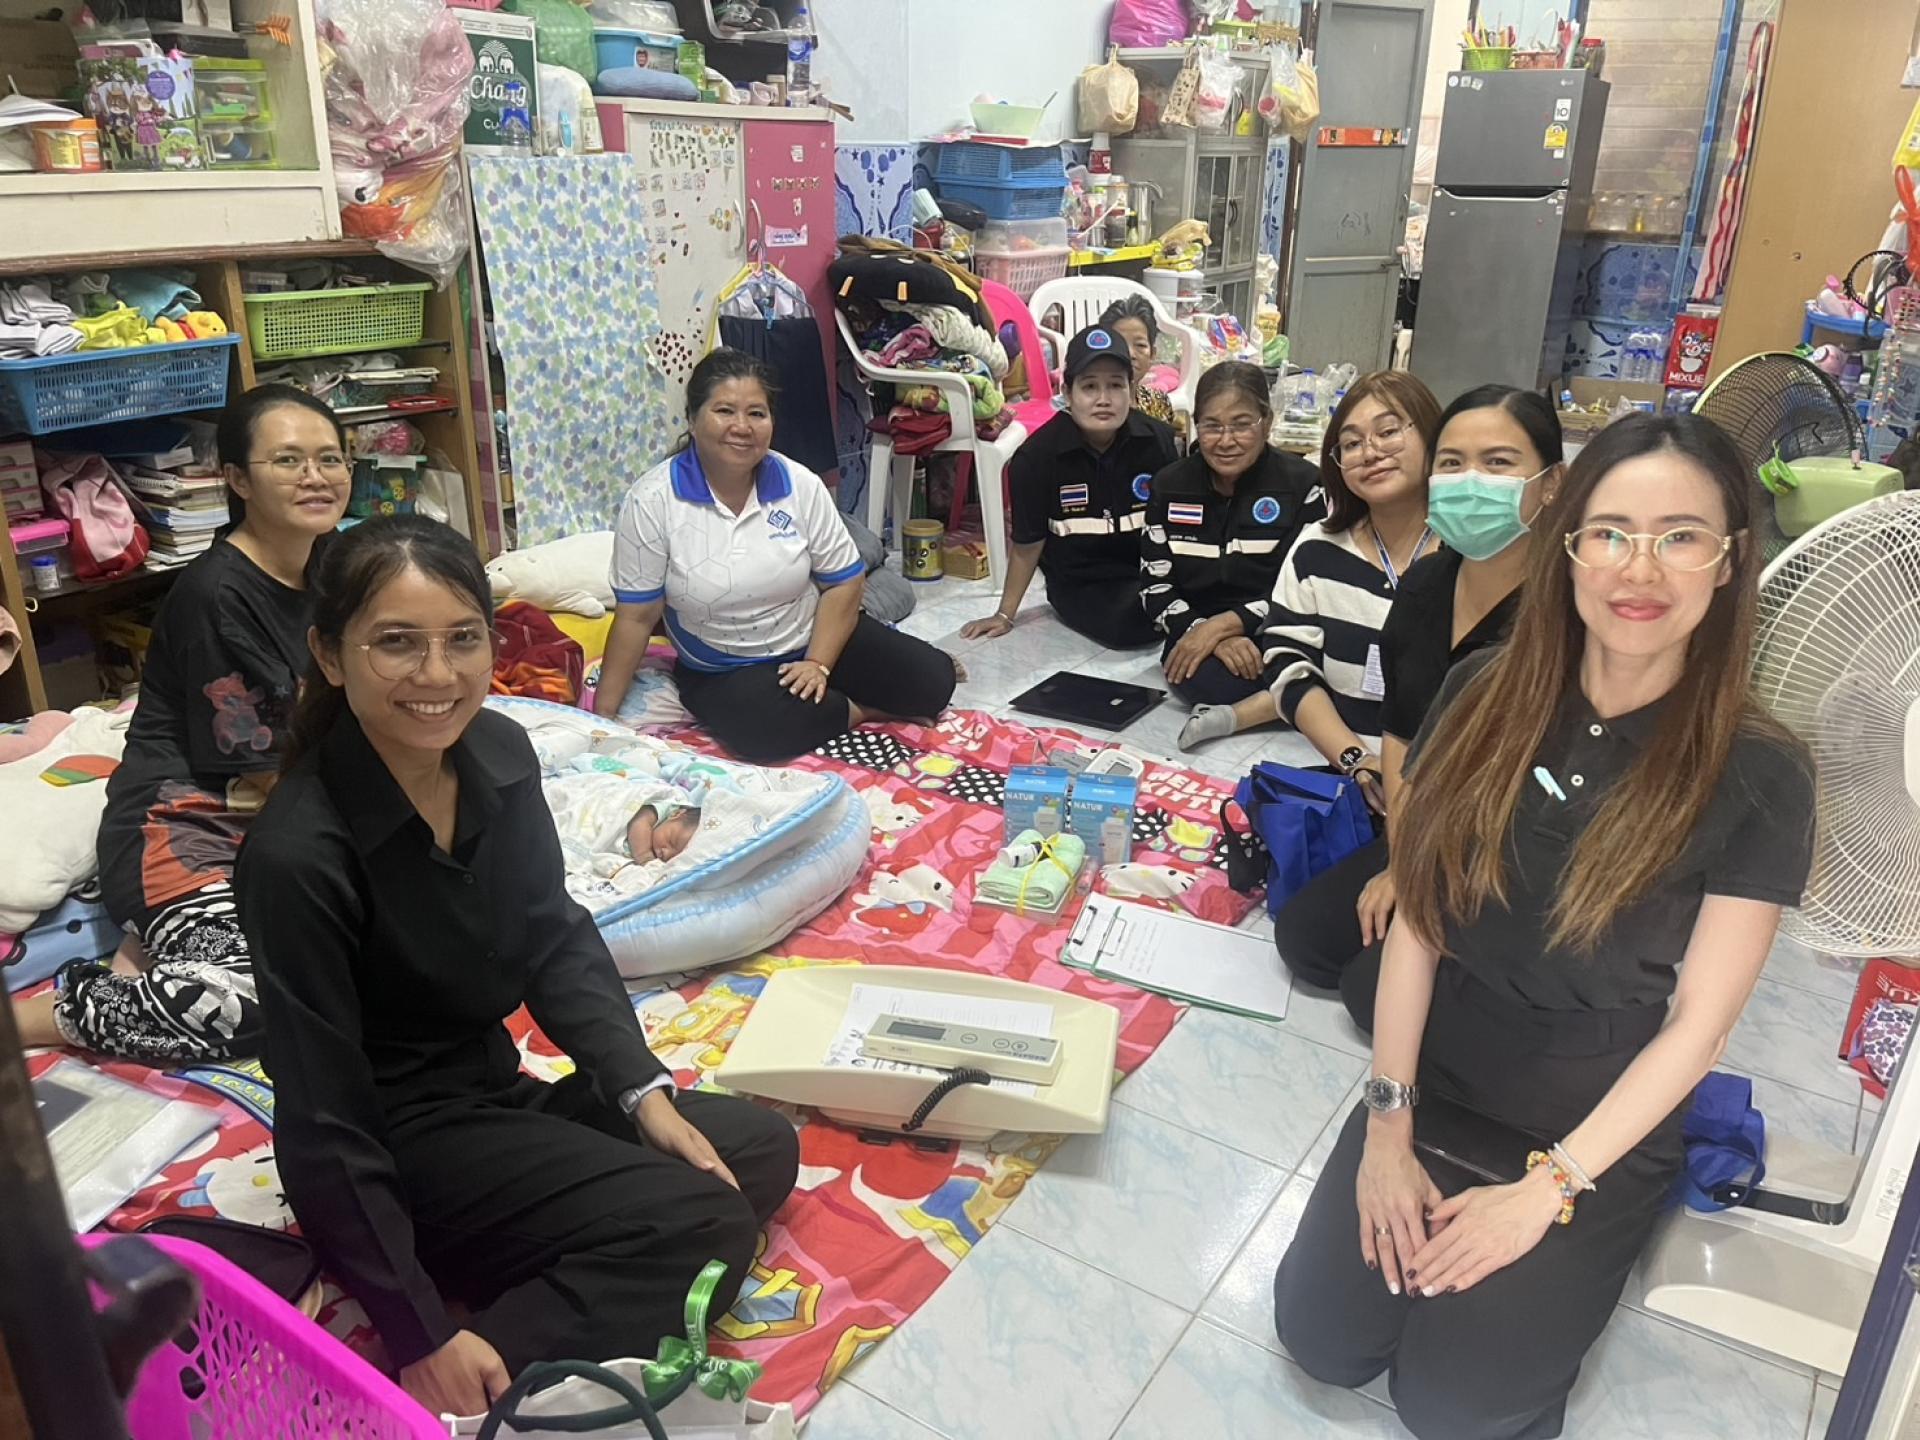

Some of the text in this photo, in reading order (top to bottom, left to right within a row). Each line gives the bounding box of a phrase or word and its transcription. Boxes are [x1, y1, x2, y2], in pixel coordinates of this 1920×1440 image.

[1668, 371, 1704, 384] MIXUE
[1006, 792, 1035, 801] NATUR
[1072, 801, 1103, 812] NATUR
